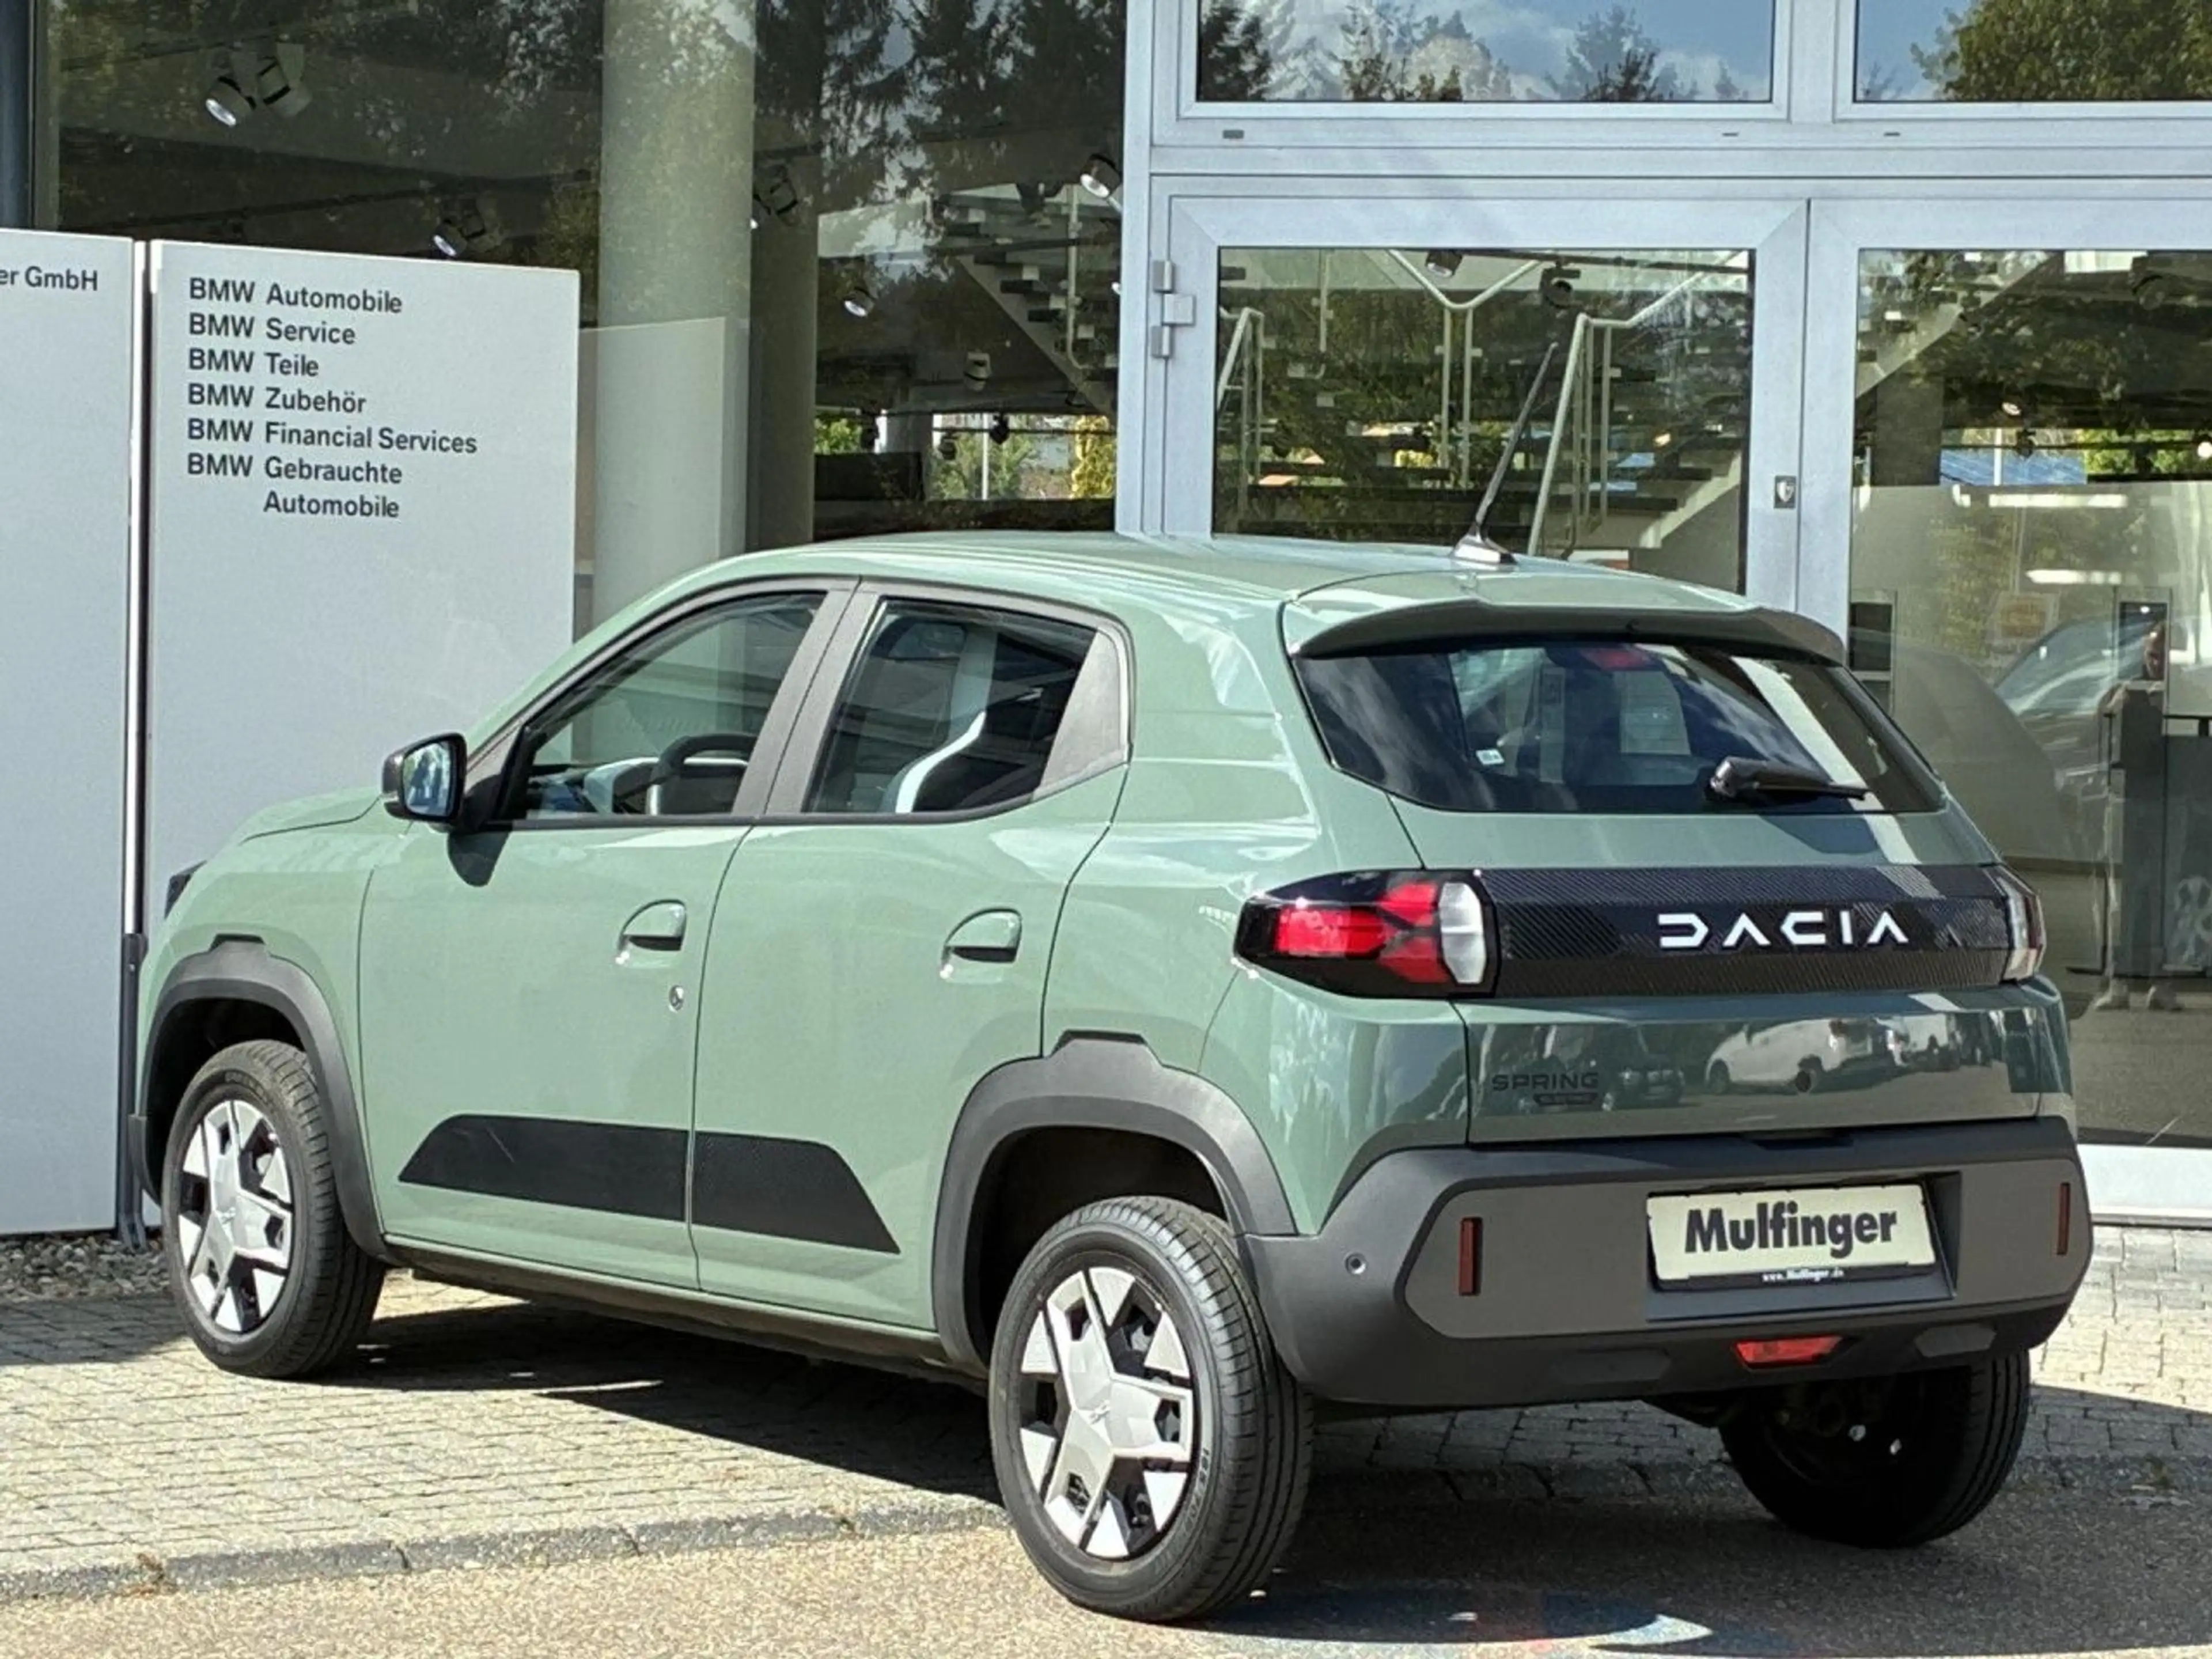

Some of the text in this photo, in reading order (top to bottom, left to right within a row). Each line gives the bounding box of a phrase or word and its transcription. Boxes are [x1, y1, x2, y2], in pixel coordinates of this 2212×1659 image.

[25, 266, 97, 291] GmbH
[190, 277, 402, 313] BMW Automobile
[190, 312, 356, 346] BMW Service
[189, 347, 319, 377] BMW Teile
[188, 382, 367, 414] BMW Zubehör
[188, 418, 478, 453] BMW Financial Services
[188, 452, 403, 484] BMW Gebrauchte
[263, 491, 399, 518] Automobile
[1658, 911, 1909, 948] DACIA
[1492, 1071, 1599, 1092] SPRING
[1685, 1200, 1897, 1259] Mulfinger
